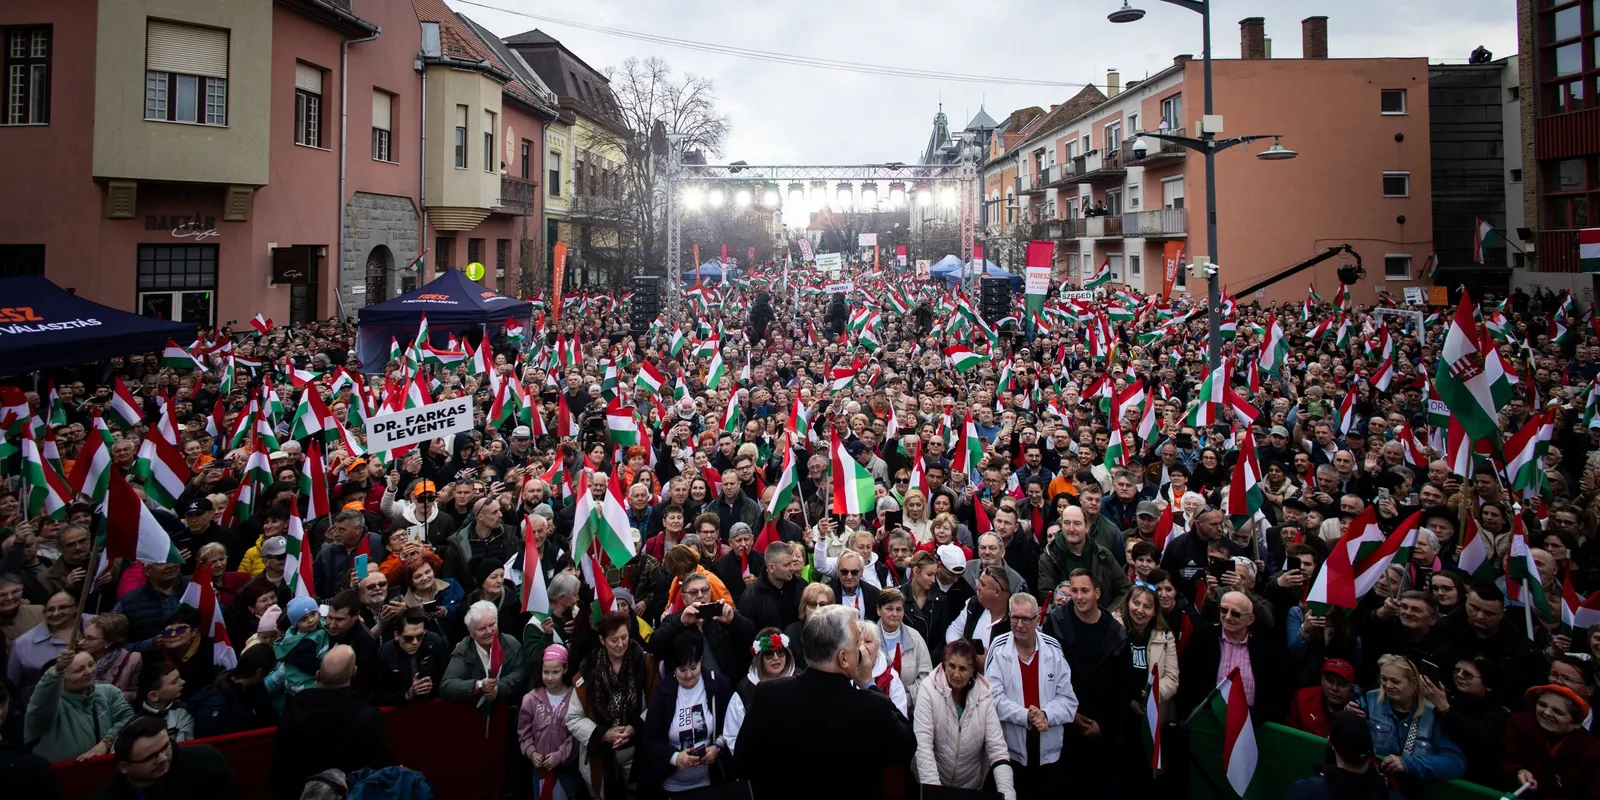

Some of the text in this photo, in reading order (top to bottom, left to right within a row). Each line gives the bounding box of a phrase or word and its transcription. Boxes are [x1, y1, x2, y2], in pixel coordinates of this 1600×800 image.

[1167, 258, 1175, 282] FIDESZ
[1062, 292, 1091, 300] SZEGED
[0, 318, 102, 335] VÁLASZTÁS
[374, 404, 467, 434] DR. FARKAS
[387, 417, 456, 442] LEVENTE
[679, 707, 691, 718] 20
[678, 715, 692, 728] 26
